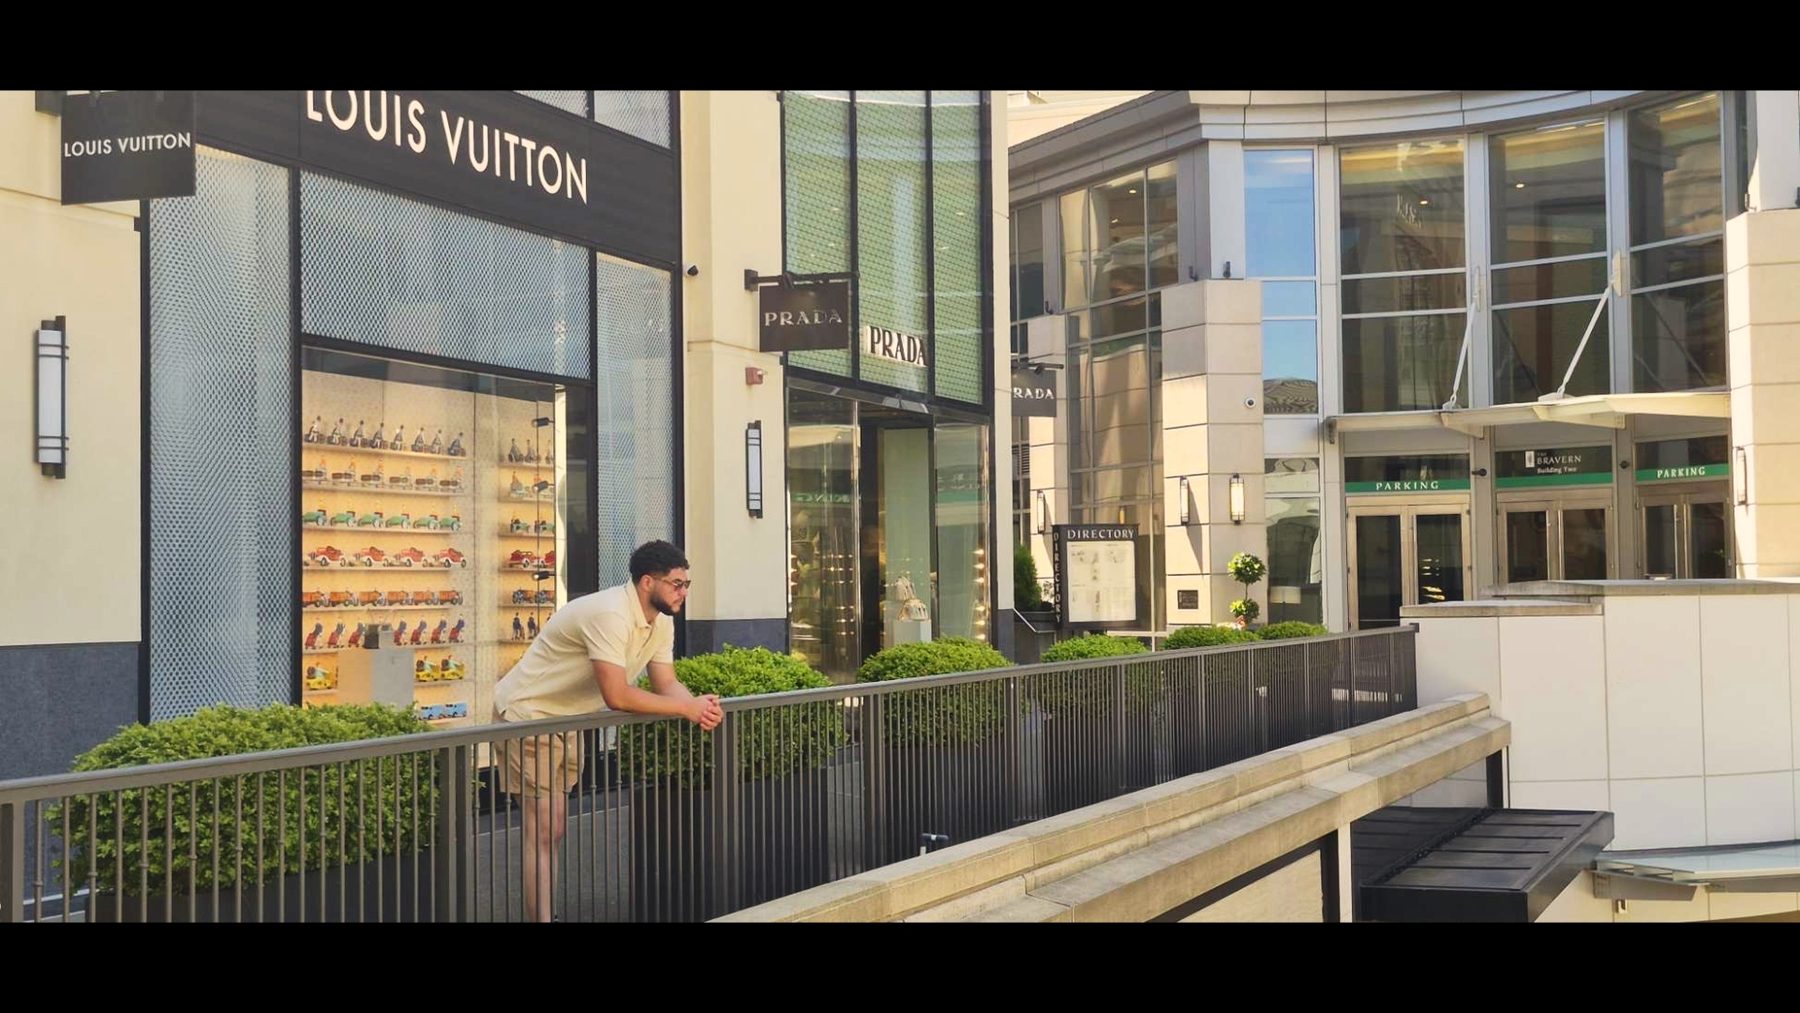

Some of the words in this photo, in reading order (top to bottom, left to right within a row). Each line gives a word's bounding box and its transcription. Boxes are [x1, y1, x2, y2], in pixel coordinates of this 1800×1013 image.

[64, 139, 112, 157] LOUIS
[118, 132, 191, 153] VUITTON
[306, 90, 427, 153] LOUIS
[440, 110, 588, 205] VUITTON
[764, 309, 842, 326] PRADA
[869, 325, 928, 366] PRADA
[1012, 386, 1055, 400] RADA
[1537, 455, 1581, 464] BRAVERN
[1656, 466, 1706, 479] PARKING
[1375, 480, 1439, 491] PARKING
[1067, 529, 1134, 539] DIRECTORY
